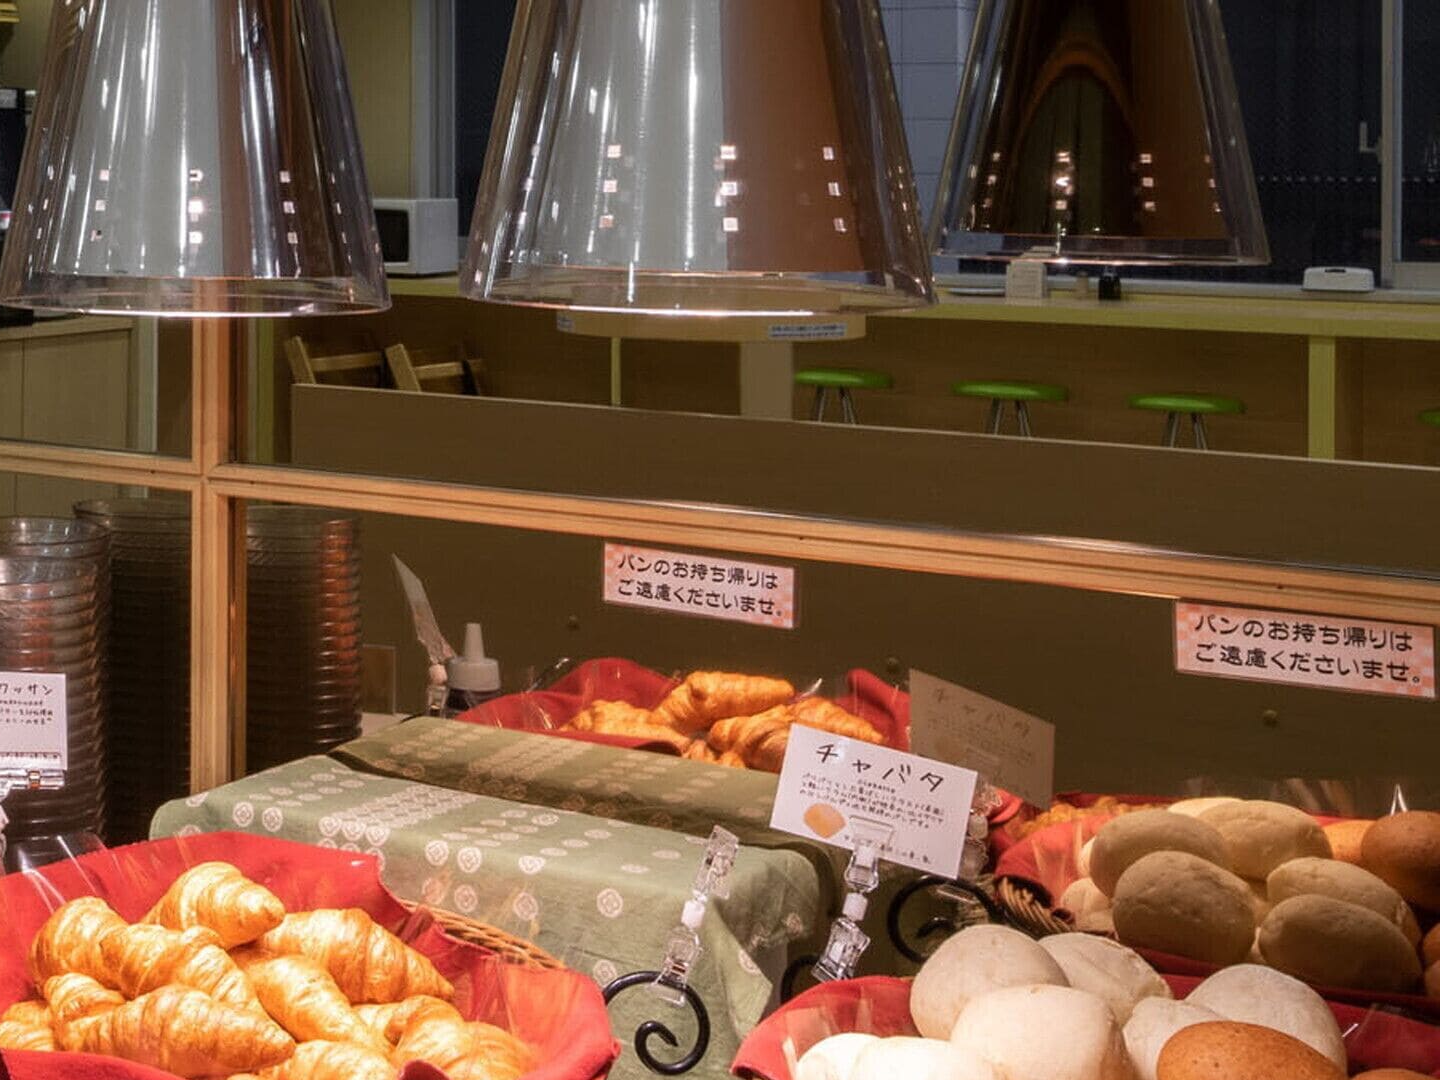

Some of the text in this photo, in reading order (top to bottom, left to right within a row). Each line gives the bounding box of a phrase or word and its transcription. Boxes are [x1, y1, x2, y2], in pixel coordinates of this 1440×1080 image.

[618, 554, 778, 590] パンのお持ち帰りは
[618, 579, 782, 617] ご遠慮くださいませ。
[1194, 614, 1413, 652] パンのお持ち帰りは
[1195, 643, 1420, 684] ご遠慮くださいませ。
[816, 744, 944, 792] チャバタ
